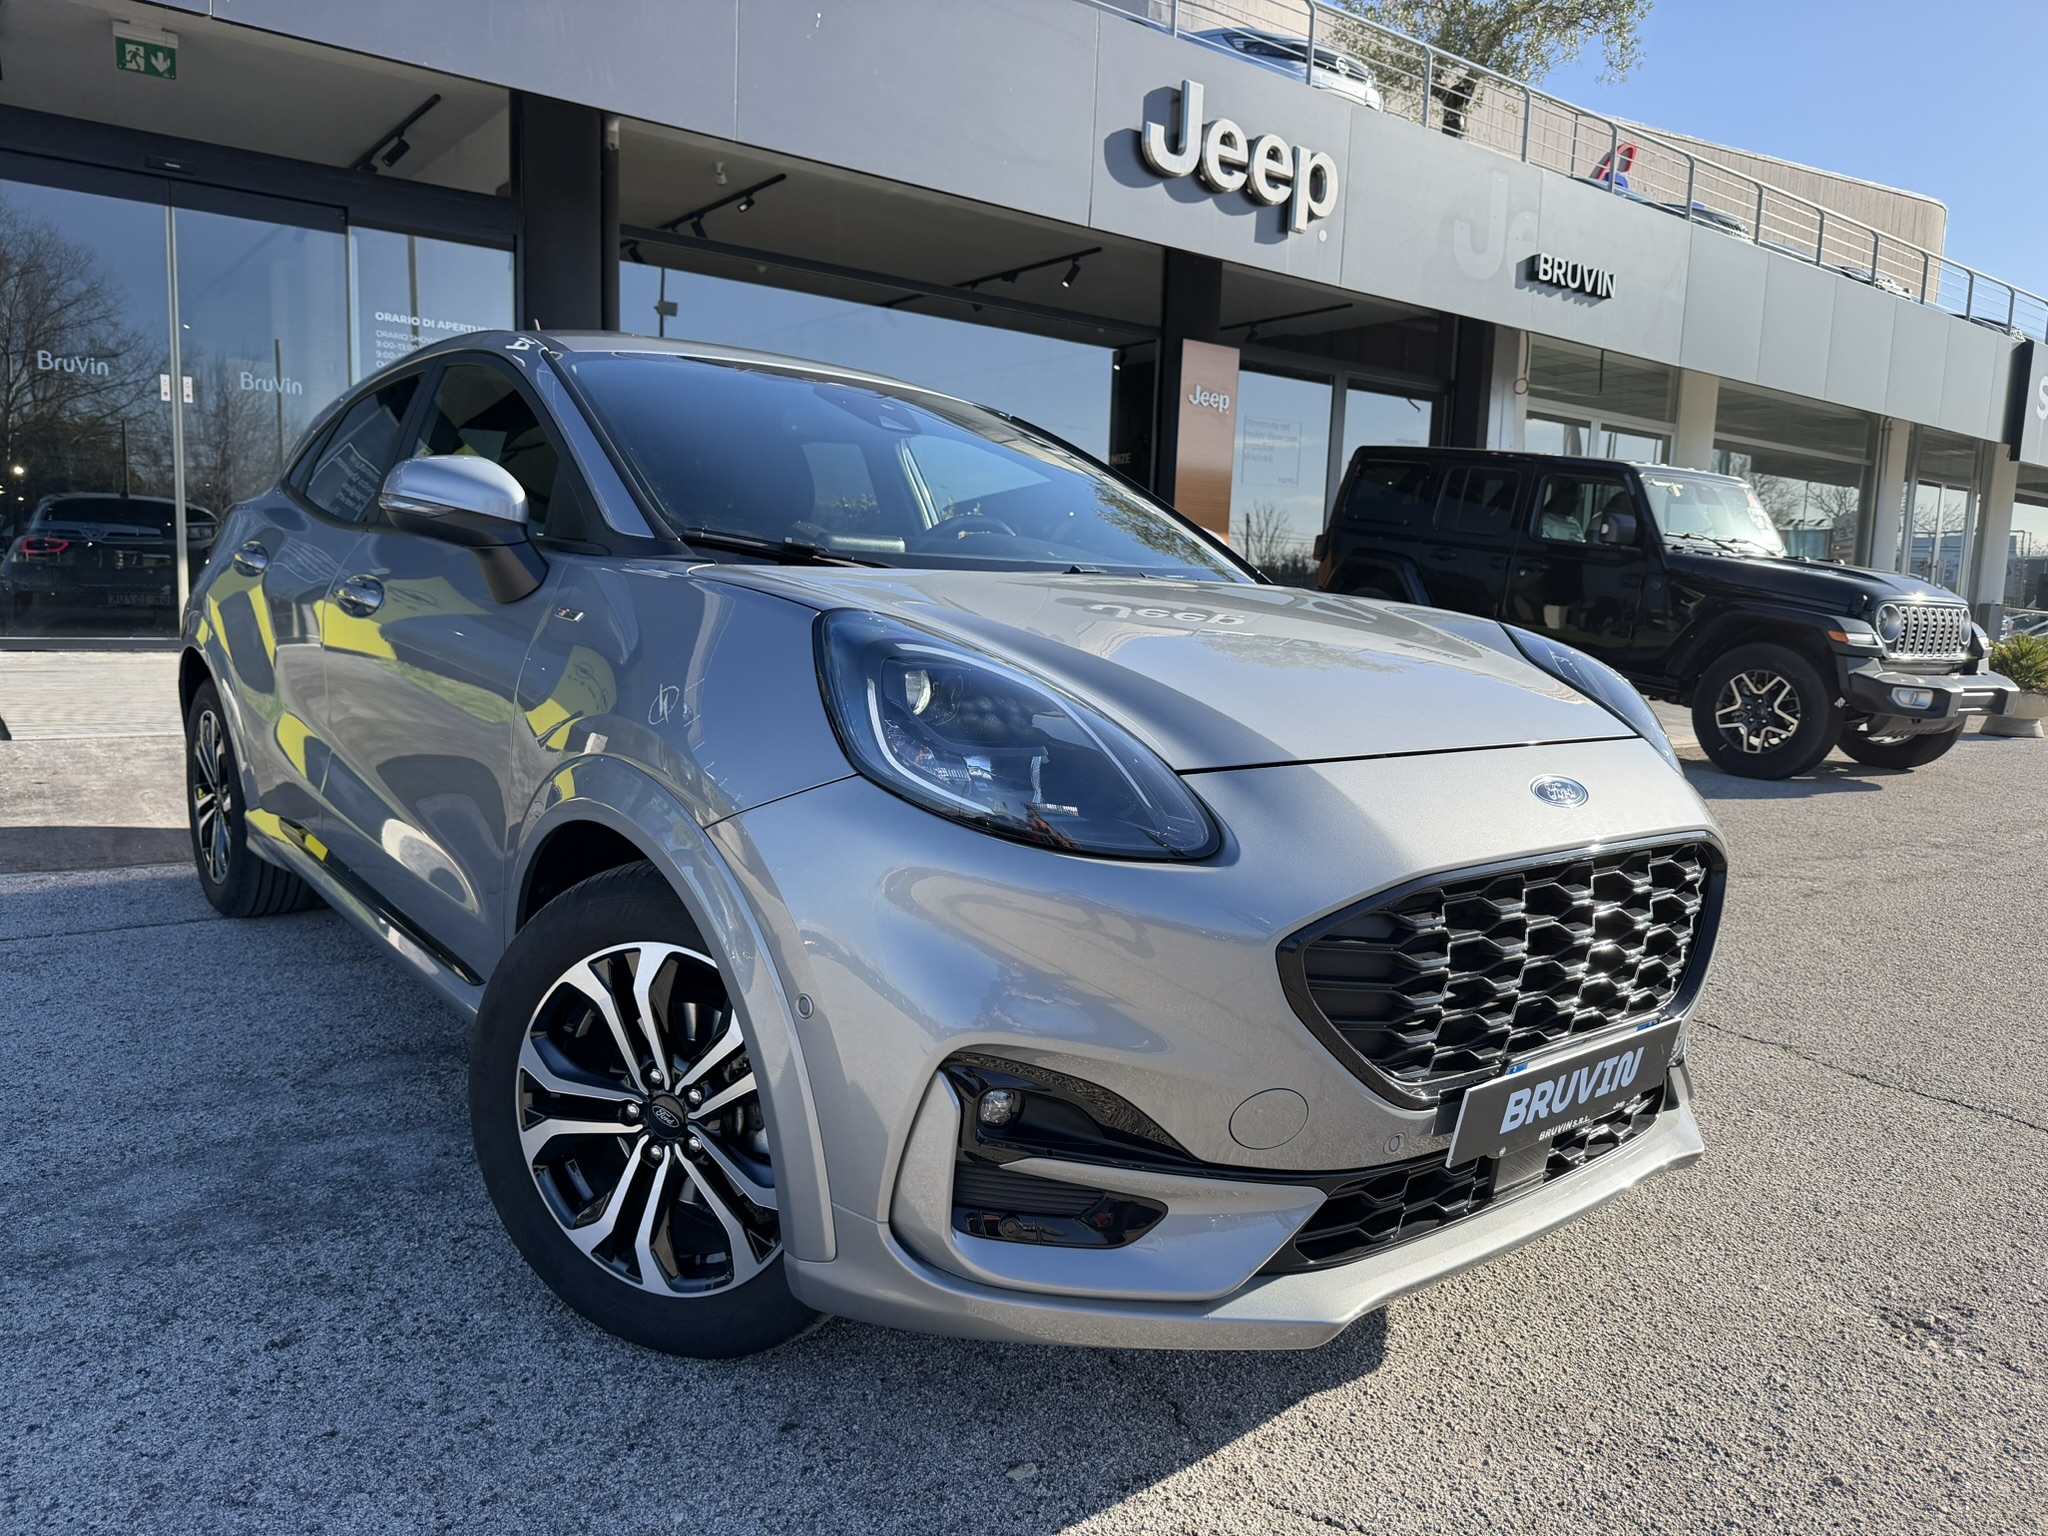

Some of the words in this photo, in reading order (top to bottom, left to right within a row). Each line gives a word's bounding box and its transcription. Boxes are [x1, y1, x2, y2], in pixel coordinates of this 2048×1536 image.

[1142, 79, 1339, 234] Jeep
[1538, 252, 1617, 299] BRUVIN
[375, 311, 420, 326] ORARIO
[422, 317, 435, 328] DI
[37, 350, 110, 376] BruVin
[239, 371, 303, 395] BruVin
[1188, 384, 1231, 413] Jeep
[1110, 452, 1132, 465] MIZE
[1499, 1046, 1645, 1135] BRUVIN
[655, 1107, 675, 1125] Ford
[1538, 1119, 1573, 1141] BRUVIN
